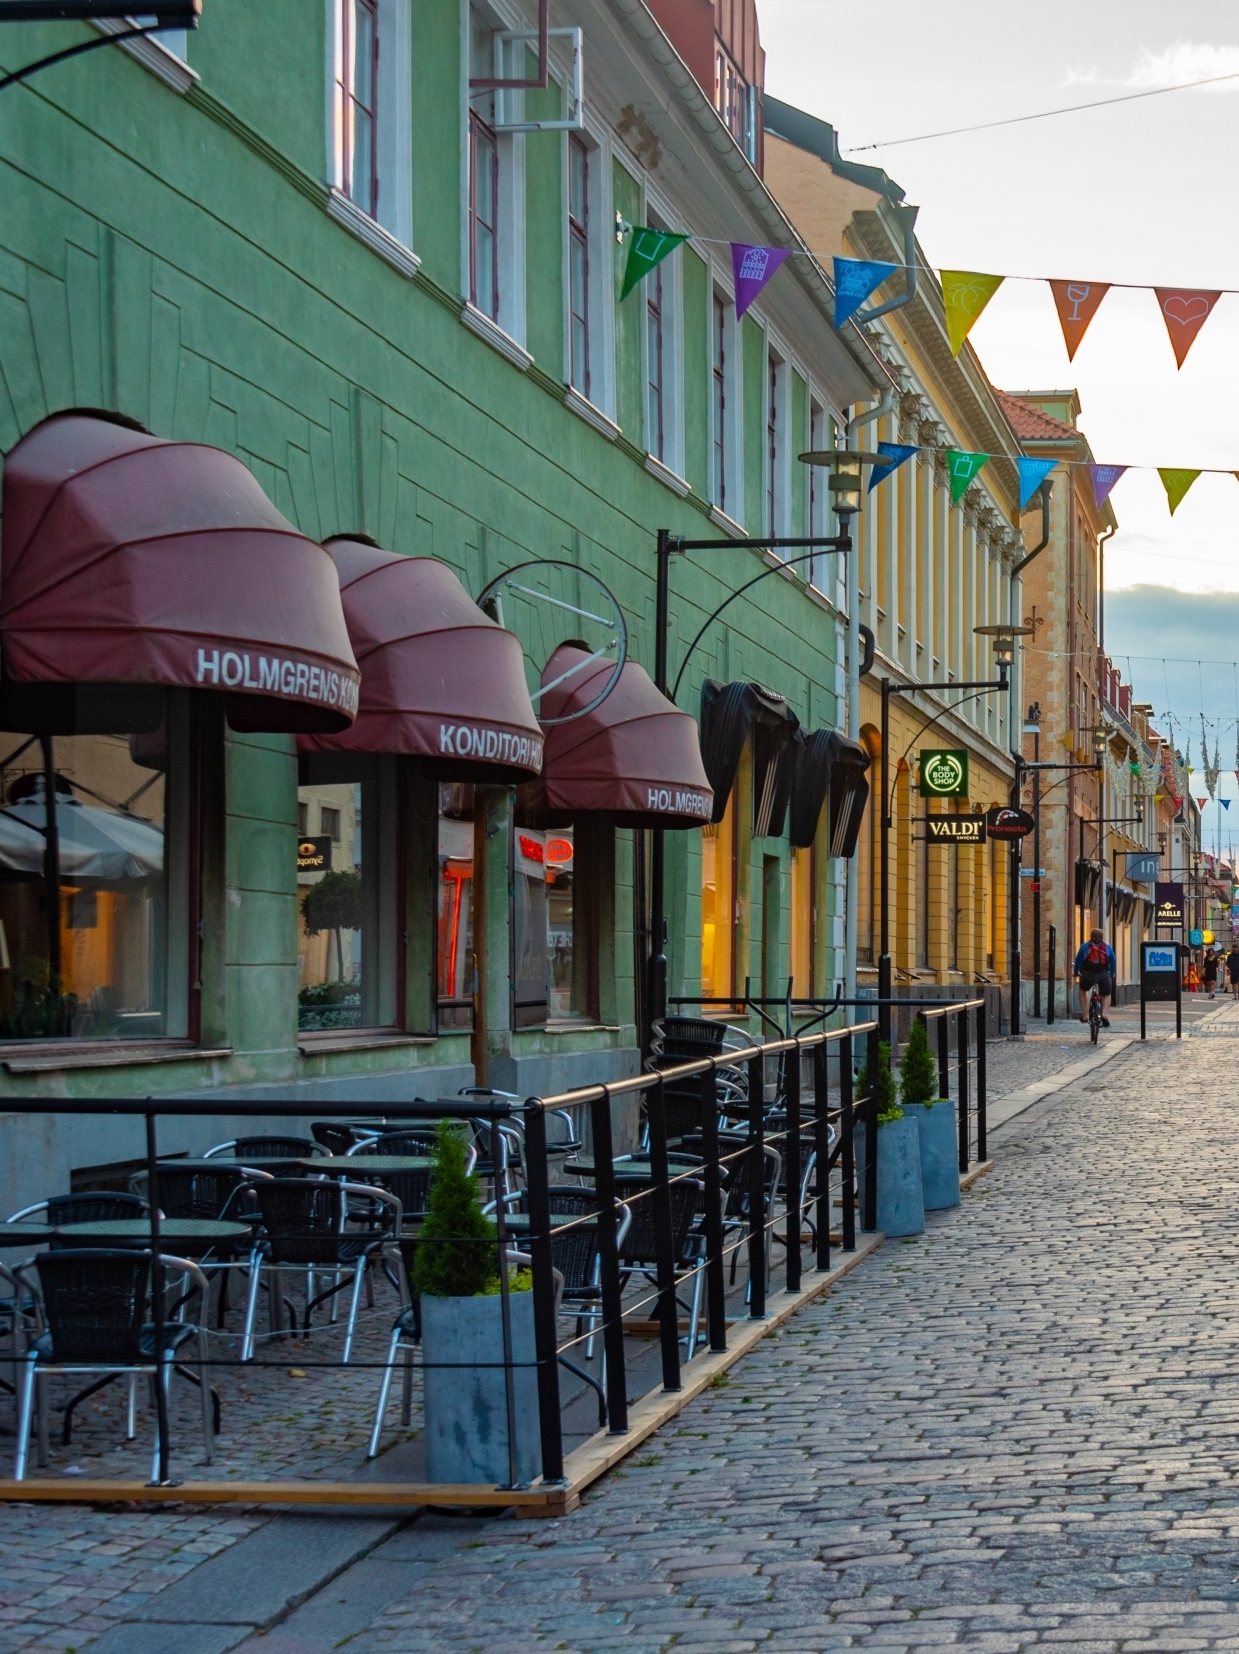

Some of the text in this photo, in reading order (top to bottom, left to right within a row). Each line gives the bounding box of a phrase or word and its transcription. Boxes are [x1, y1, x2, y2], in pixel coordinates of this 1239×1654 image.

[197, 648, 339, 706] HOLMGRENS
[440, 724, 530, 765] KONDITORI
[647, 788, 710, 817] HOLMGRENS
[929, 822, 979, 835] VALDI
